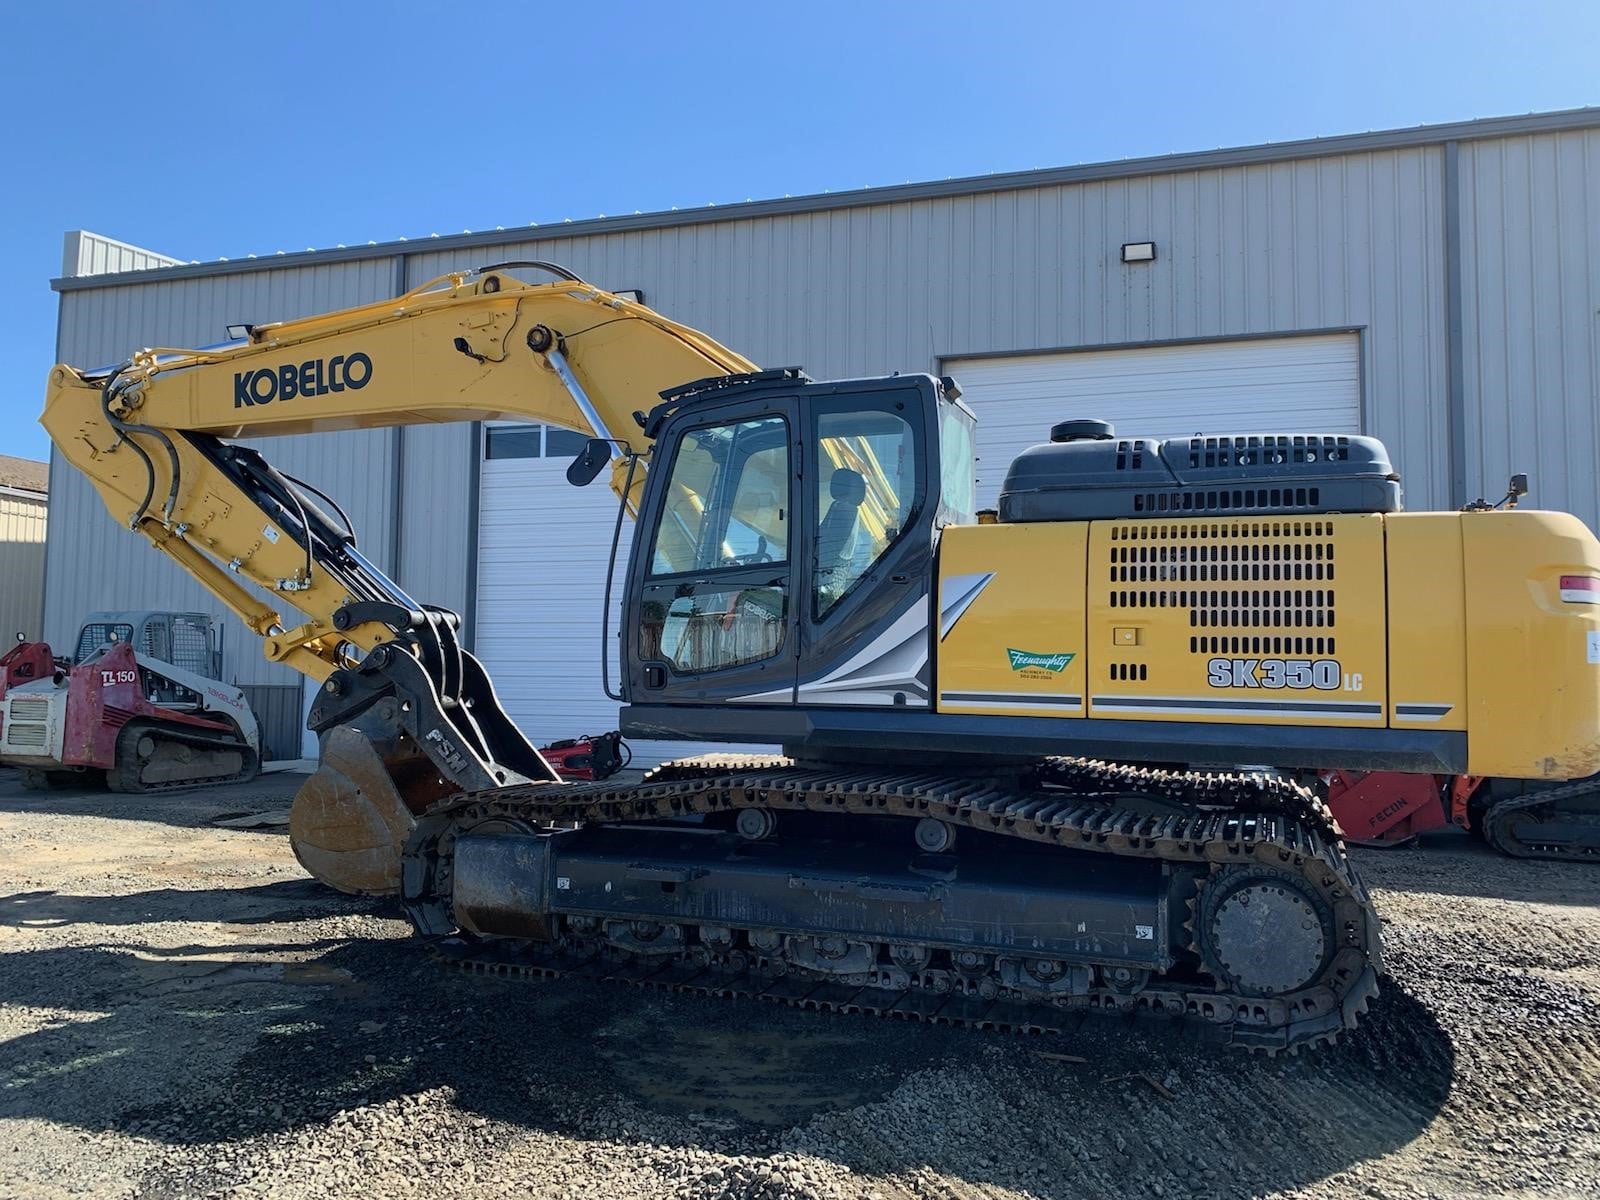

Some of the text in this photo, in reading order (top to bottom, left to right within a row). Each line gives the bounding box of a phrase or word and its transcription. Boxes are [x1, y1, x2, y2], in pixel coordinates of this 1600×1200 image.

[234, 352, 373, 408] KOBELCO
[1208, 658, 1362, 691] SK350 LC
[1369, 797, 1408, 828] FECON
